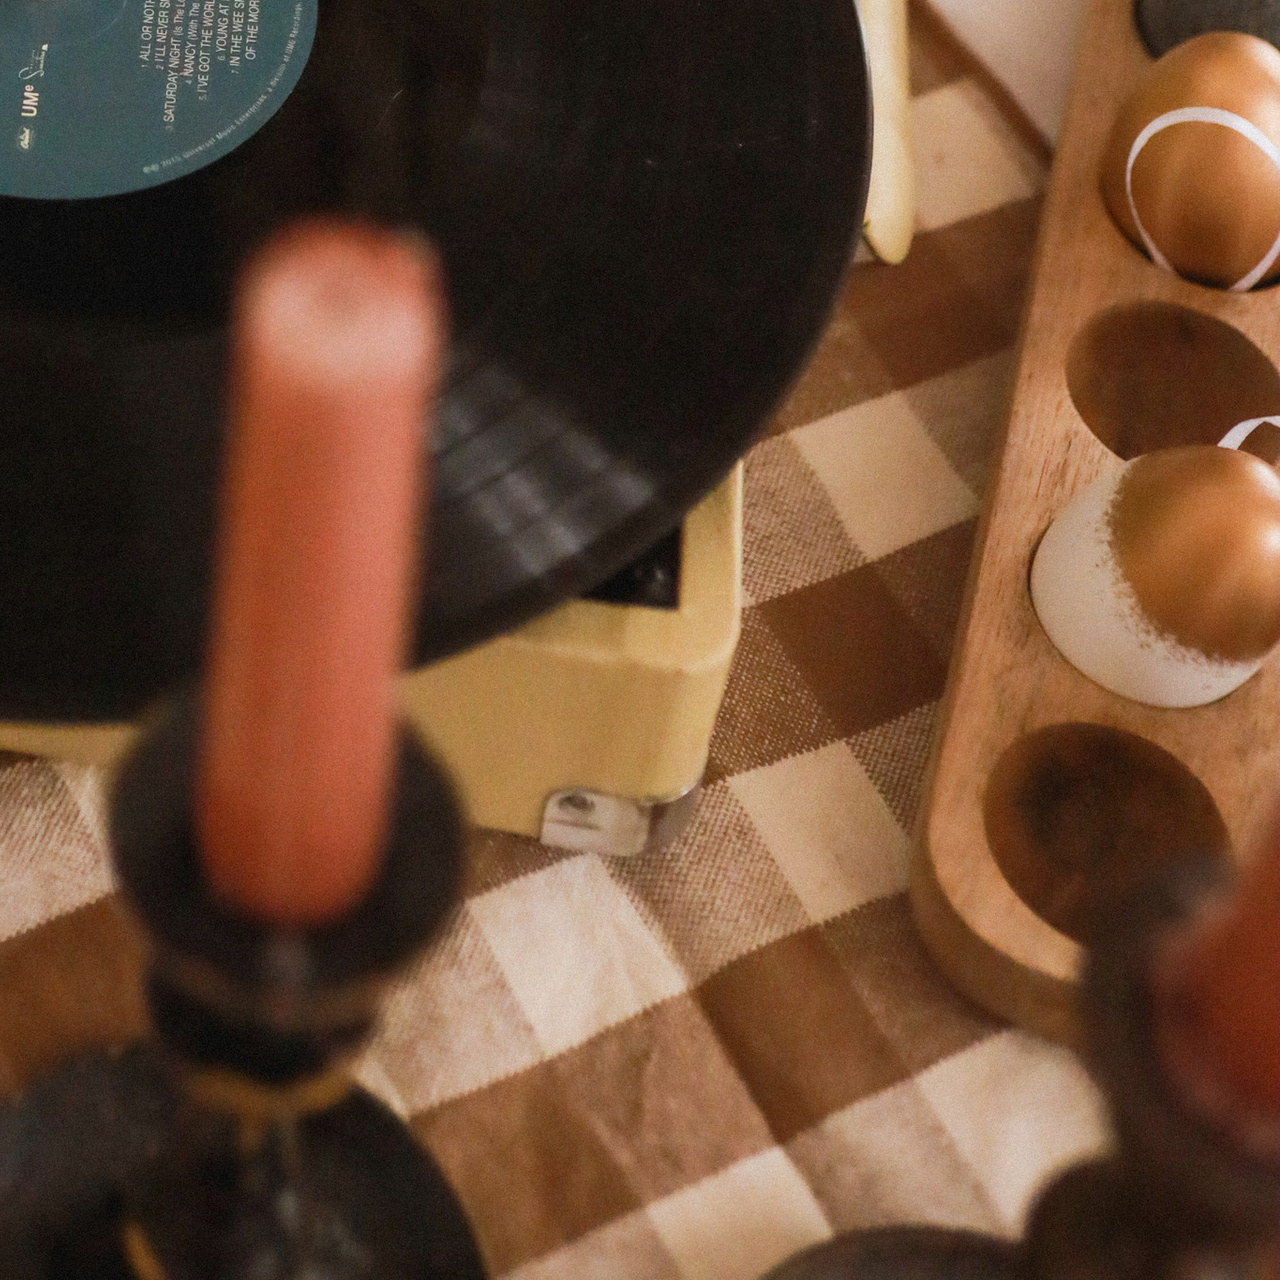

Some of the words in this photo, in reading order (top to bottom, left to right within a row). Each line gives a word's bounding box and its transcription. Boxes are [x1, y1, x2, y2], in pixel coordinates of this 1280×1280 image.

[174, 9, 184, 23] The
[188, 2, 200, 16] The
[219, 4, 230, 16] AT
[156, 10, 168, 42] NEVER
[187, 20, 198, 40] (With
[232, 12, 244, 32] WEE
[141, 26, 152, 40] OR
[200, 30, 212, 48] THE
[216, 18, 228, 52] YOUNG
[246, 24, 258, 44] THE
[139, 44, 151, 61] ALL
[154, 45, 166, 62] I'LL
[168, 37, 181, 68] NIGHT
[230, 34, 242, 54] THE
[245, 46, 256, 60] OF
[183, 42, 196, 76] NANCY
[199, 50, 210, 72] GOT
[230, 56, 240, 66] IN
[197, 74, 208, 92] I'VE
[163, 70, 178, 122] SATURDAY
